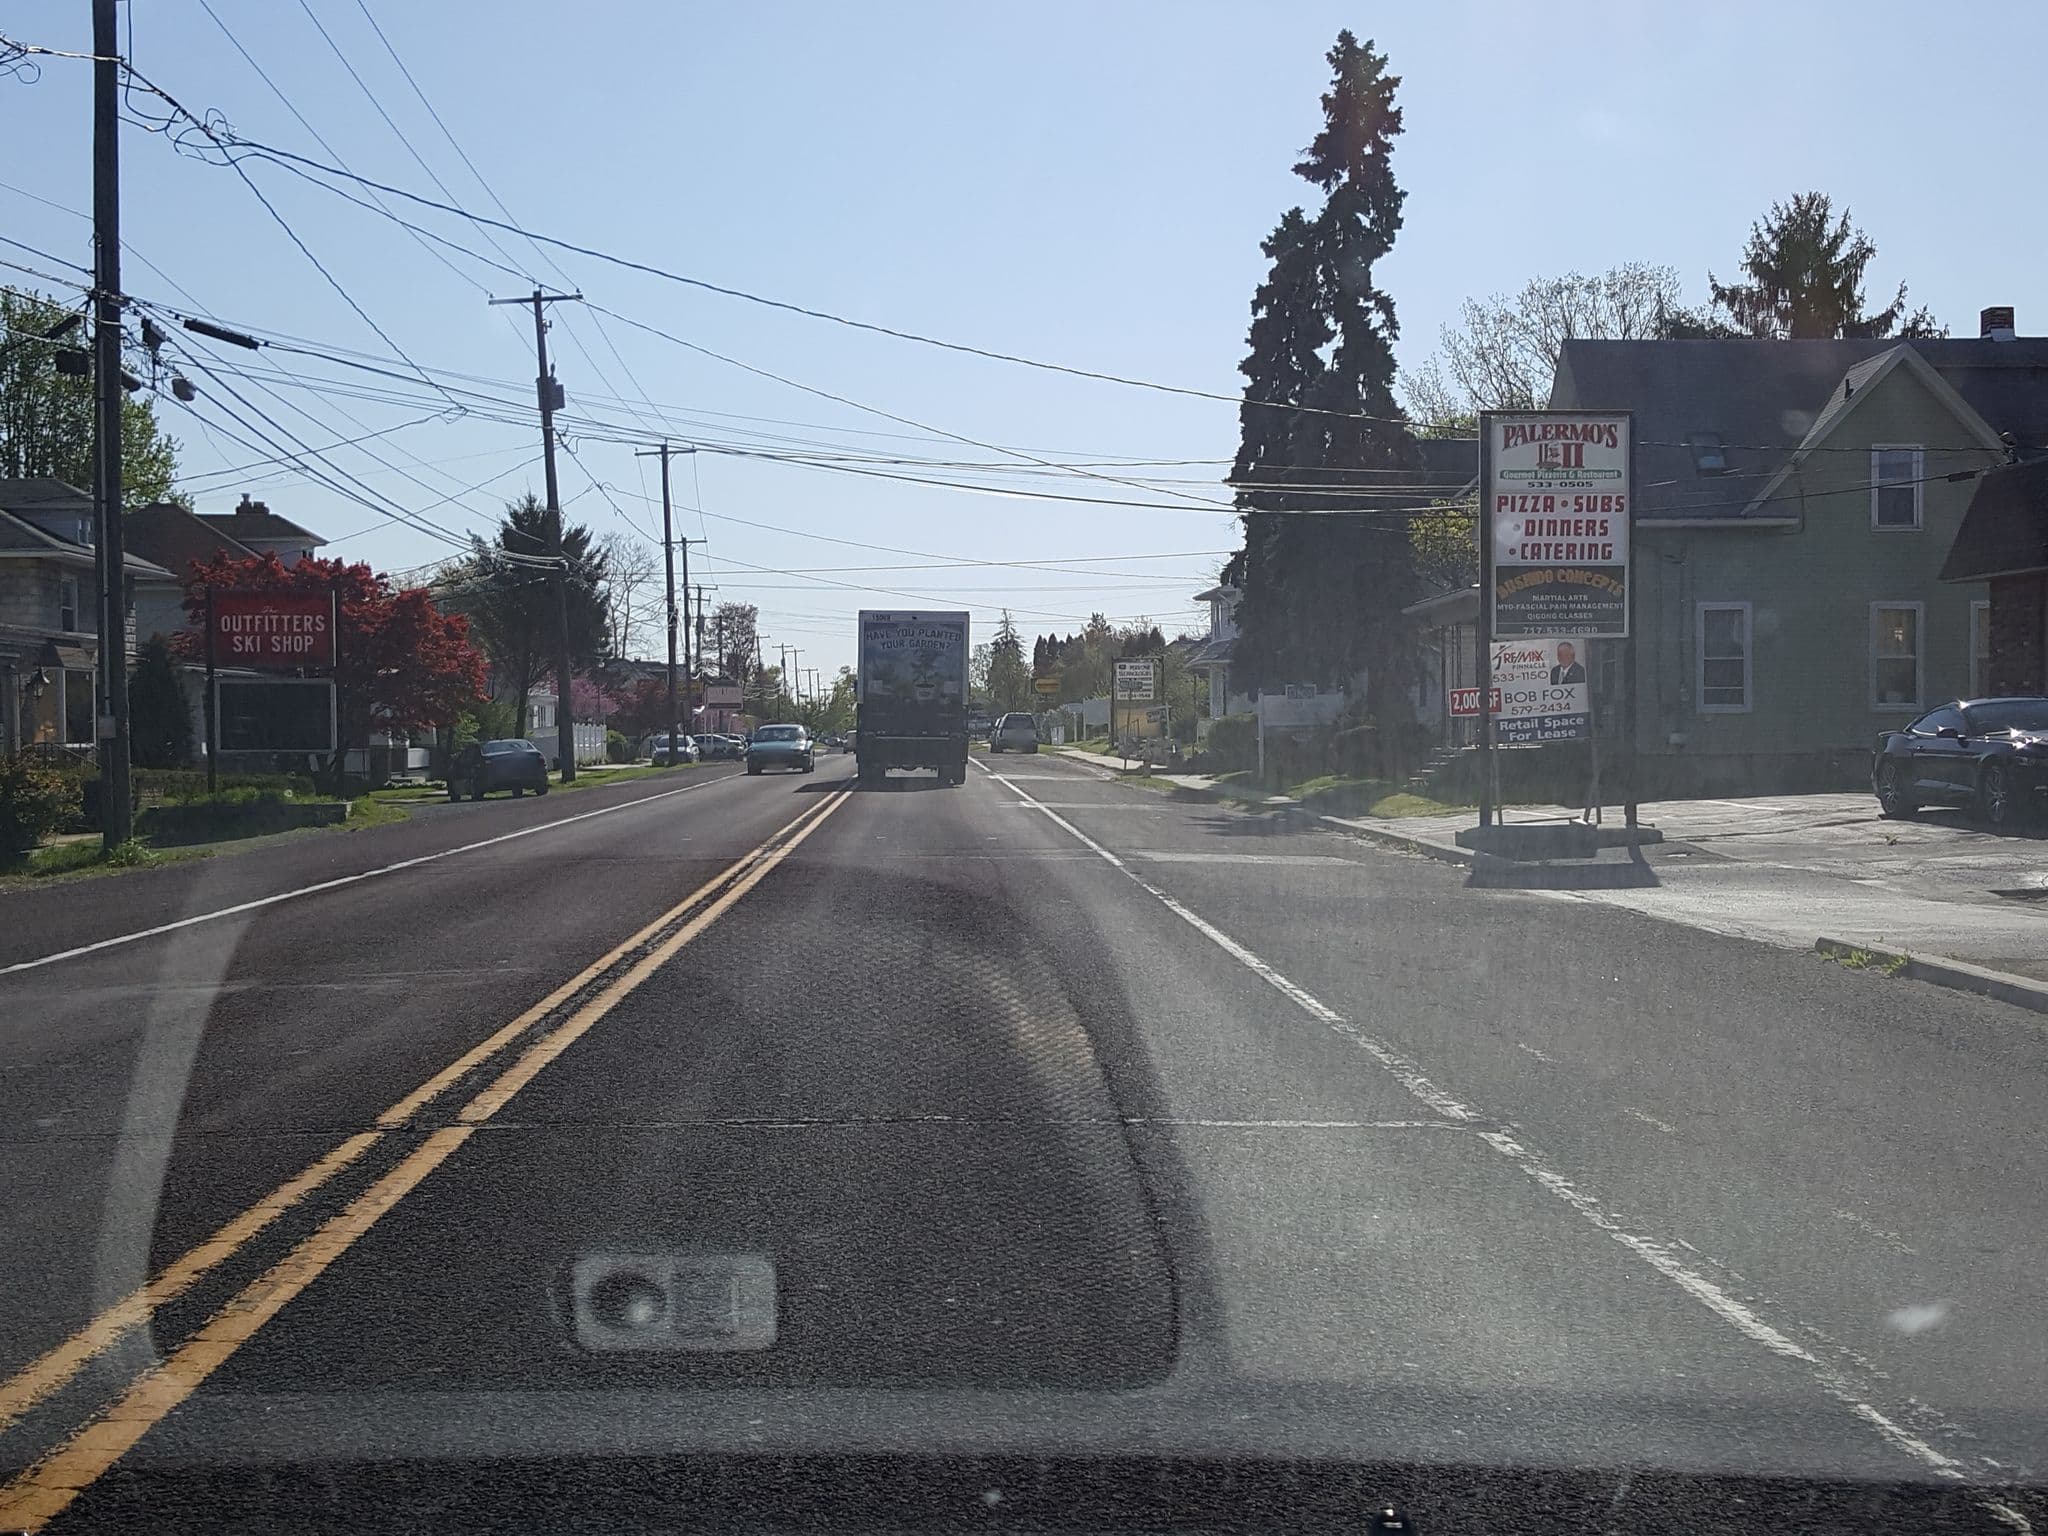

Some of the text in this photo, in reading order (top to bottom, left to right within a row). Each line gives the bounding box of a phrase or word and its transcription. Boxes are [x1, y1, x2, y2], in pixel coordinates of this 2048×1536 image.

[1503, 423, 1618, 451] PALERMO'S
[1577, 470, 1618, 479] Restaurant
[1496, 495, 1625, 513] PIZZA SUBS
[1524, 519, 1609, 537] DINNERS
[1520, 543, 1613, 561] CATERING
[220, 615, 326, 632] OUTFITTERS
[866, 627, 962, 641] HAVE YOU PLANTED
[232, 636, 314, 653] SKI SHOP
[880, 639, 952, 650] YOUR GARDEN?
[1503, 650, 1545, 664] RE/MAX
[1493, 670, 1548, 683] 533-1150
[1504, 687, 1576, 704] BOB FOX
[1511, 702, 1571, 715] 579-2434
[1499, 716, 1585, 731] Retail Space
[1509, 727, 1576, 742] For Lease
